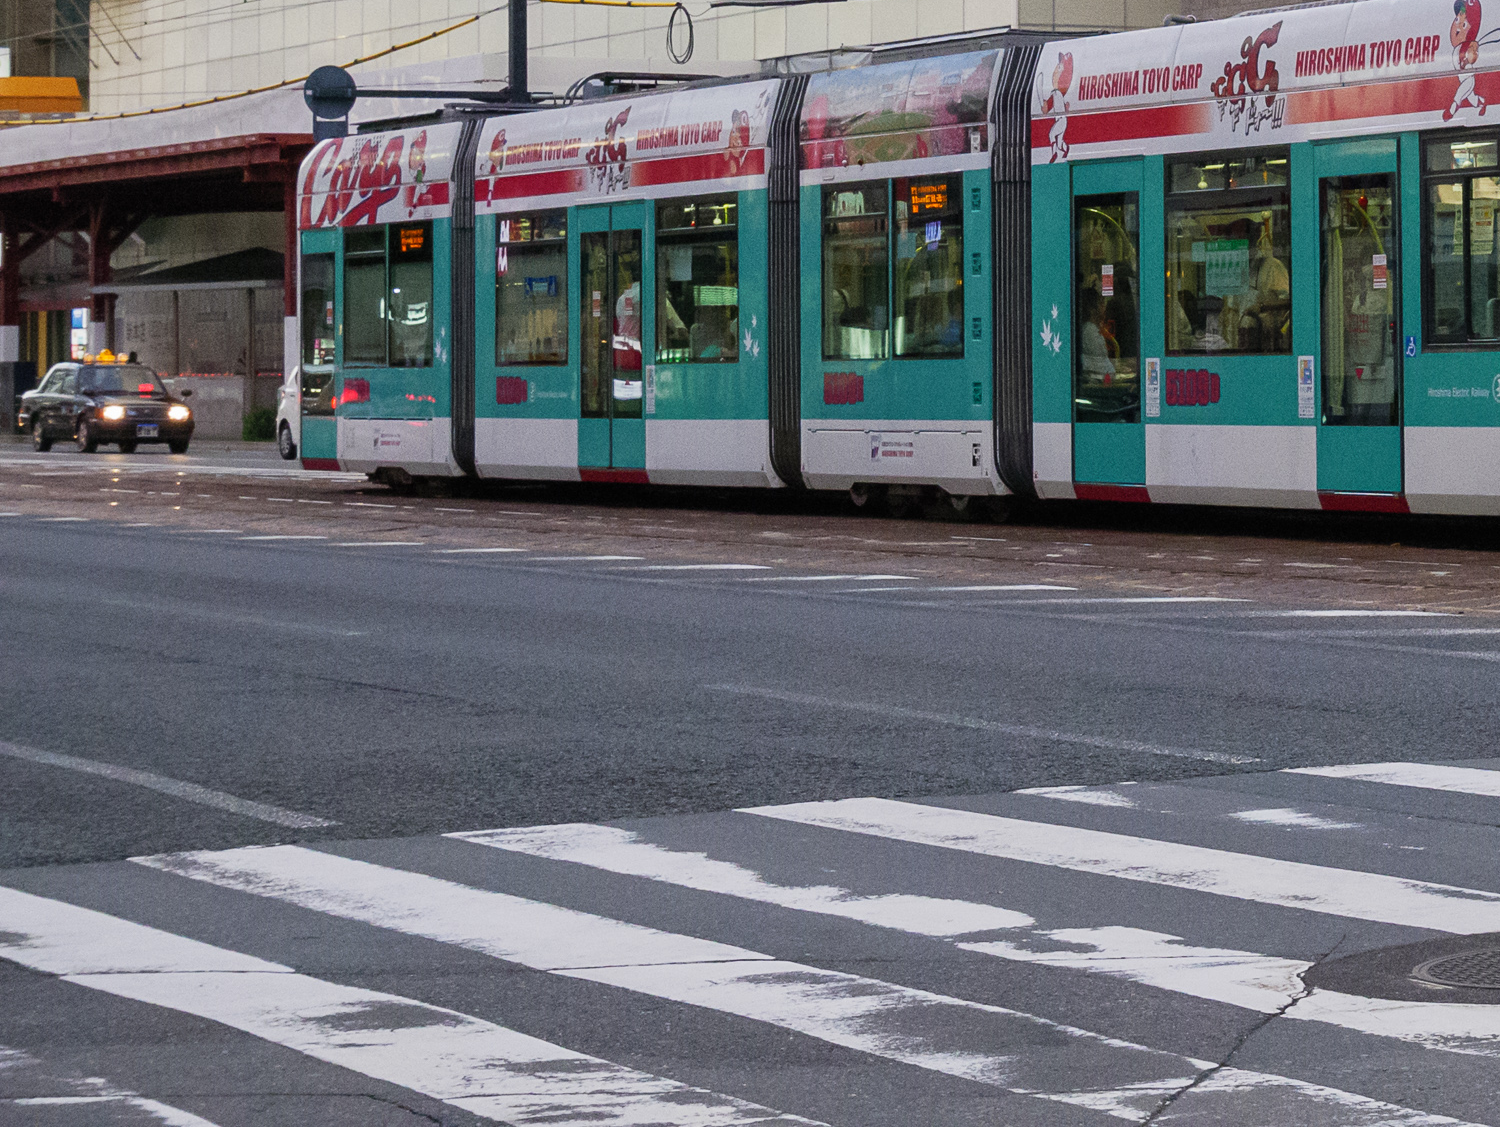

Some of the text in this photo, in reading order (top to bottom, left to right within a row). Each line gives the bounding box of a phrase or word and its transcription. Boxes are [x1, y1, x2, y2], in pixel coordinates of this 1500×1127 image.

[1295, 34, 1440, 77] HIROSHIMA TOYO CARP
[1078, 63, 1203, 101] HIROSHIMA TOYO CARP
[636, 120, 722, 151] HIROSHIMA TOYO CARP
